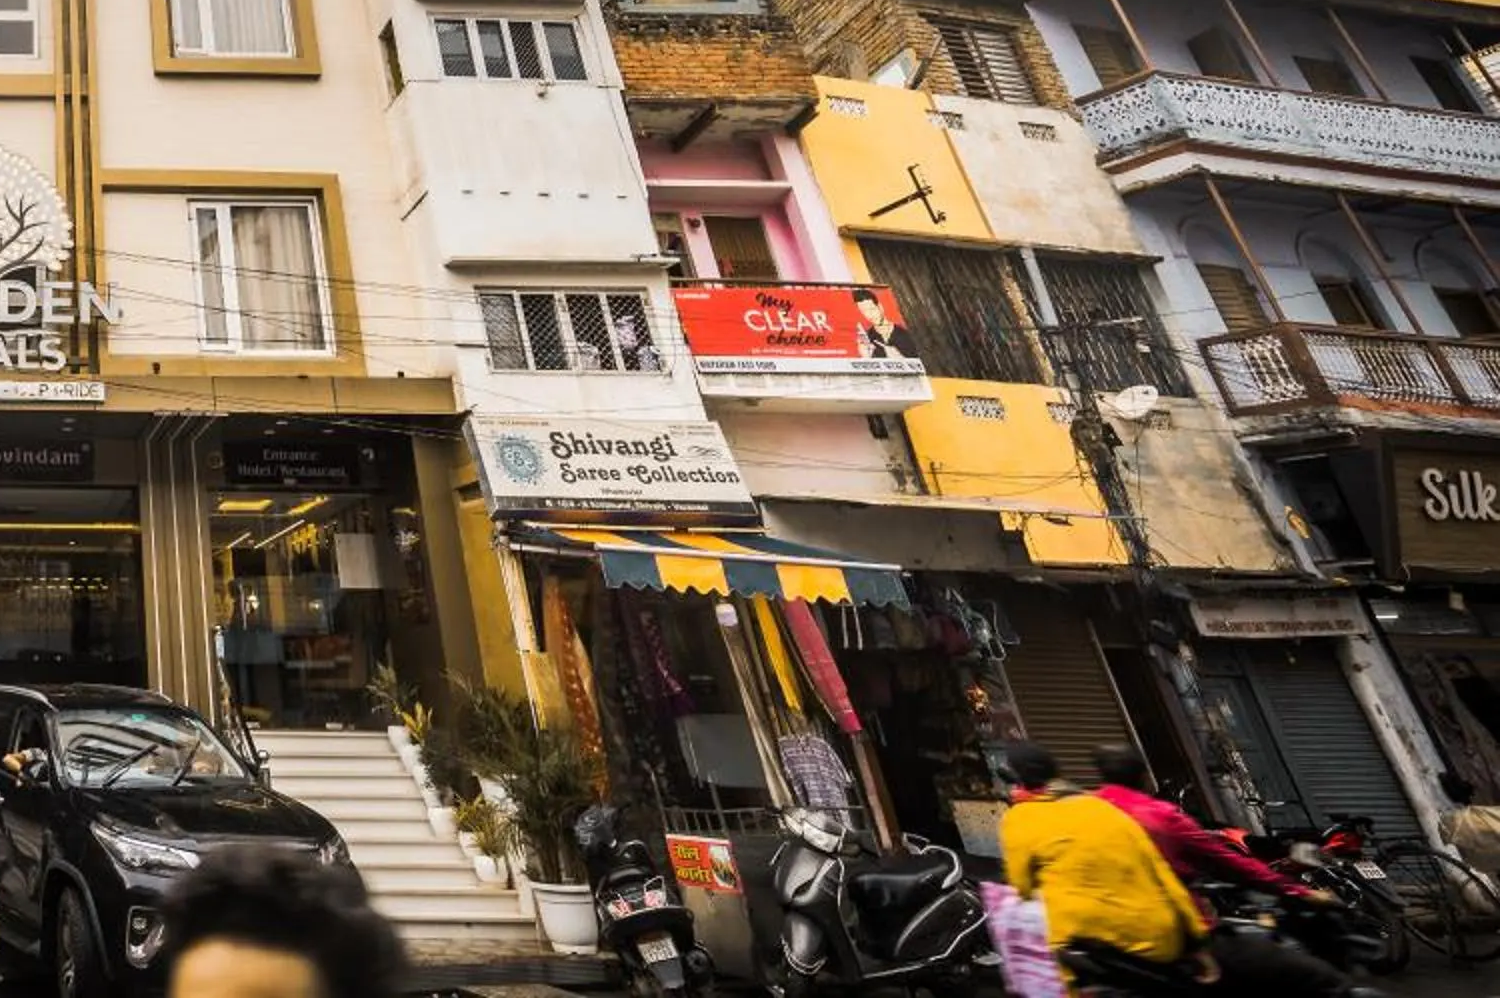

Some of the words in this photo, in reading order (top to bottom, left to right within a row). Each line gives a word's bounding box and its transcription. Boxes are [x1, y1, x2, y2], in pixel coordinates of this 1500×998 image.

[756, 292, 793, 313] My
[743, 310, 833, 333] CLEAR
[550, 431, 678, 462] Shivangi
[560, 463, 621, 485] Saree
[627, 465, 741, 485] Collection
[1421, 468, 1500, 522] Silk
